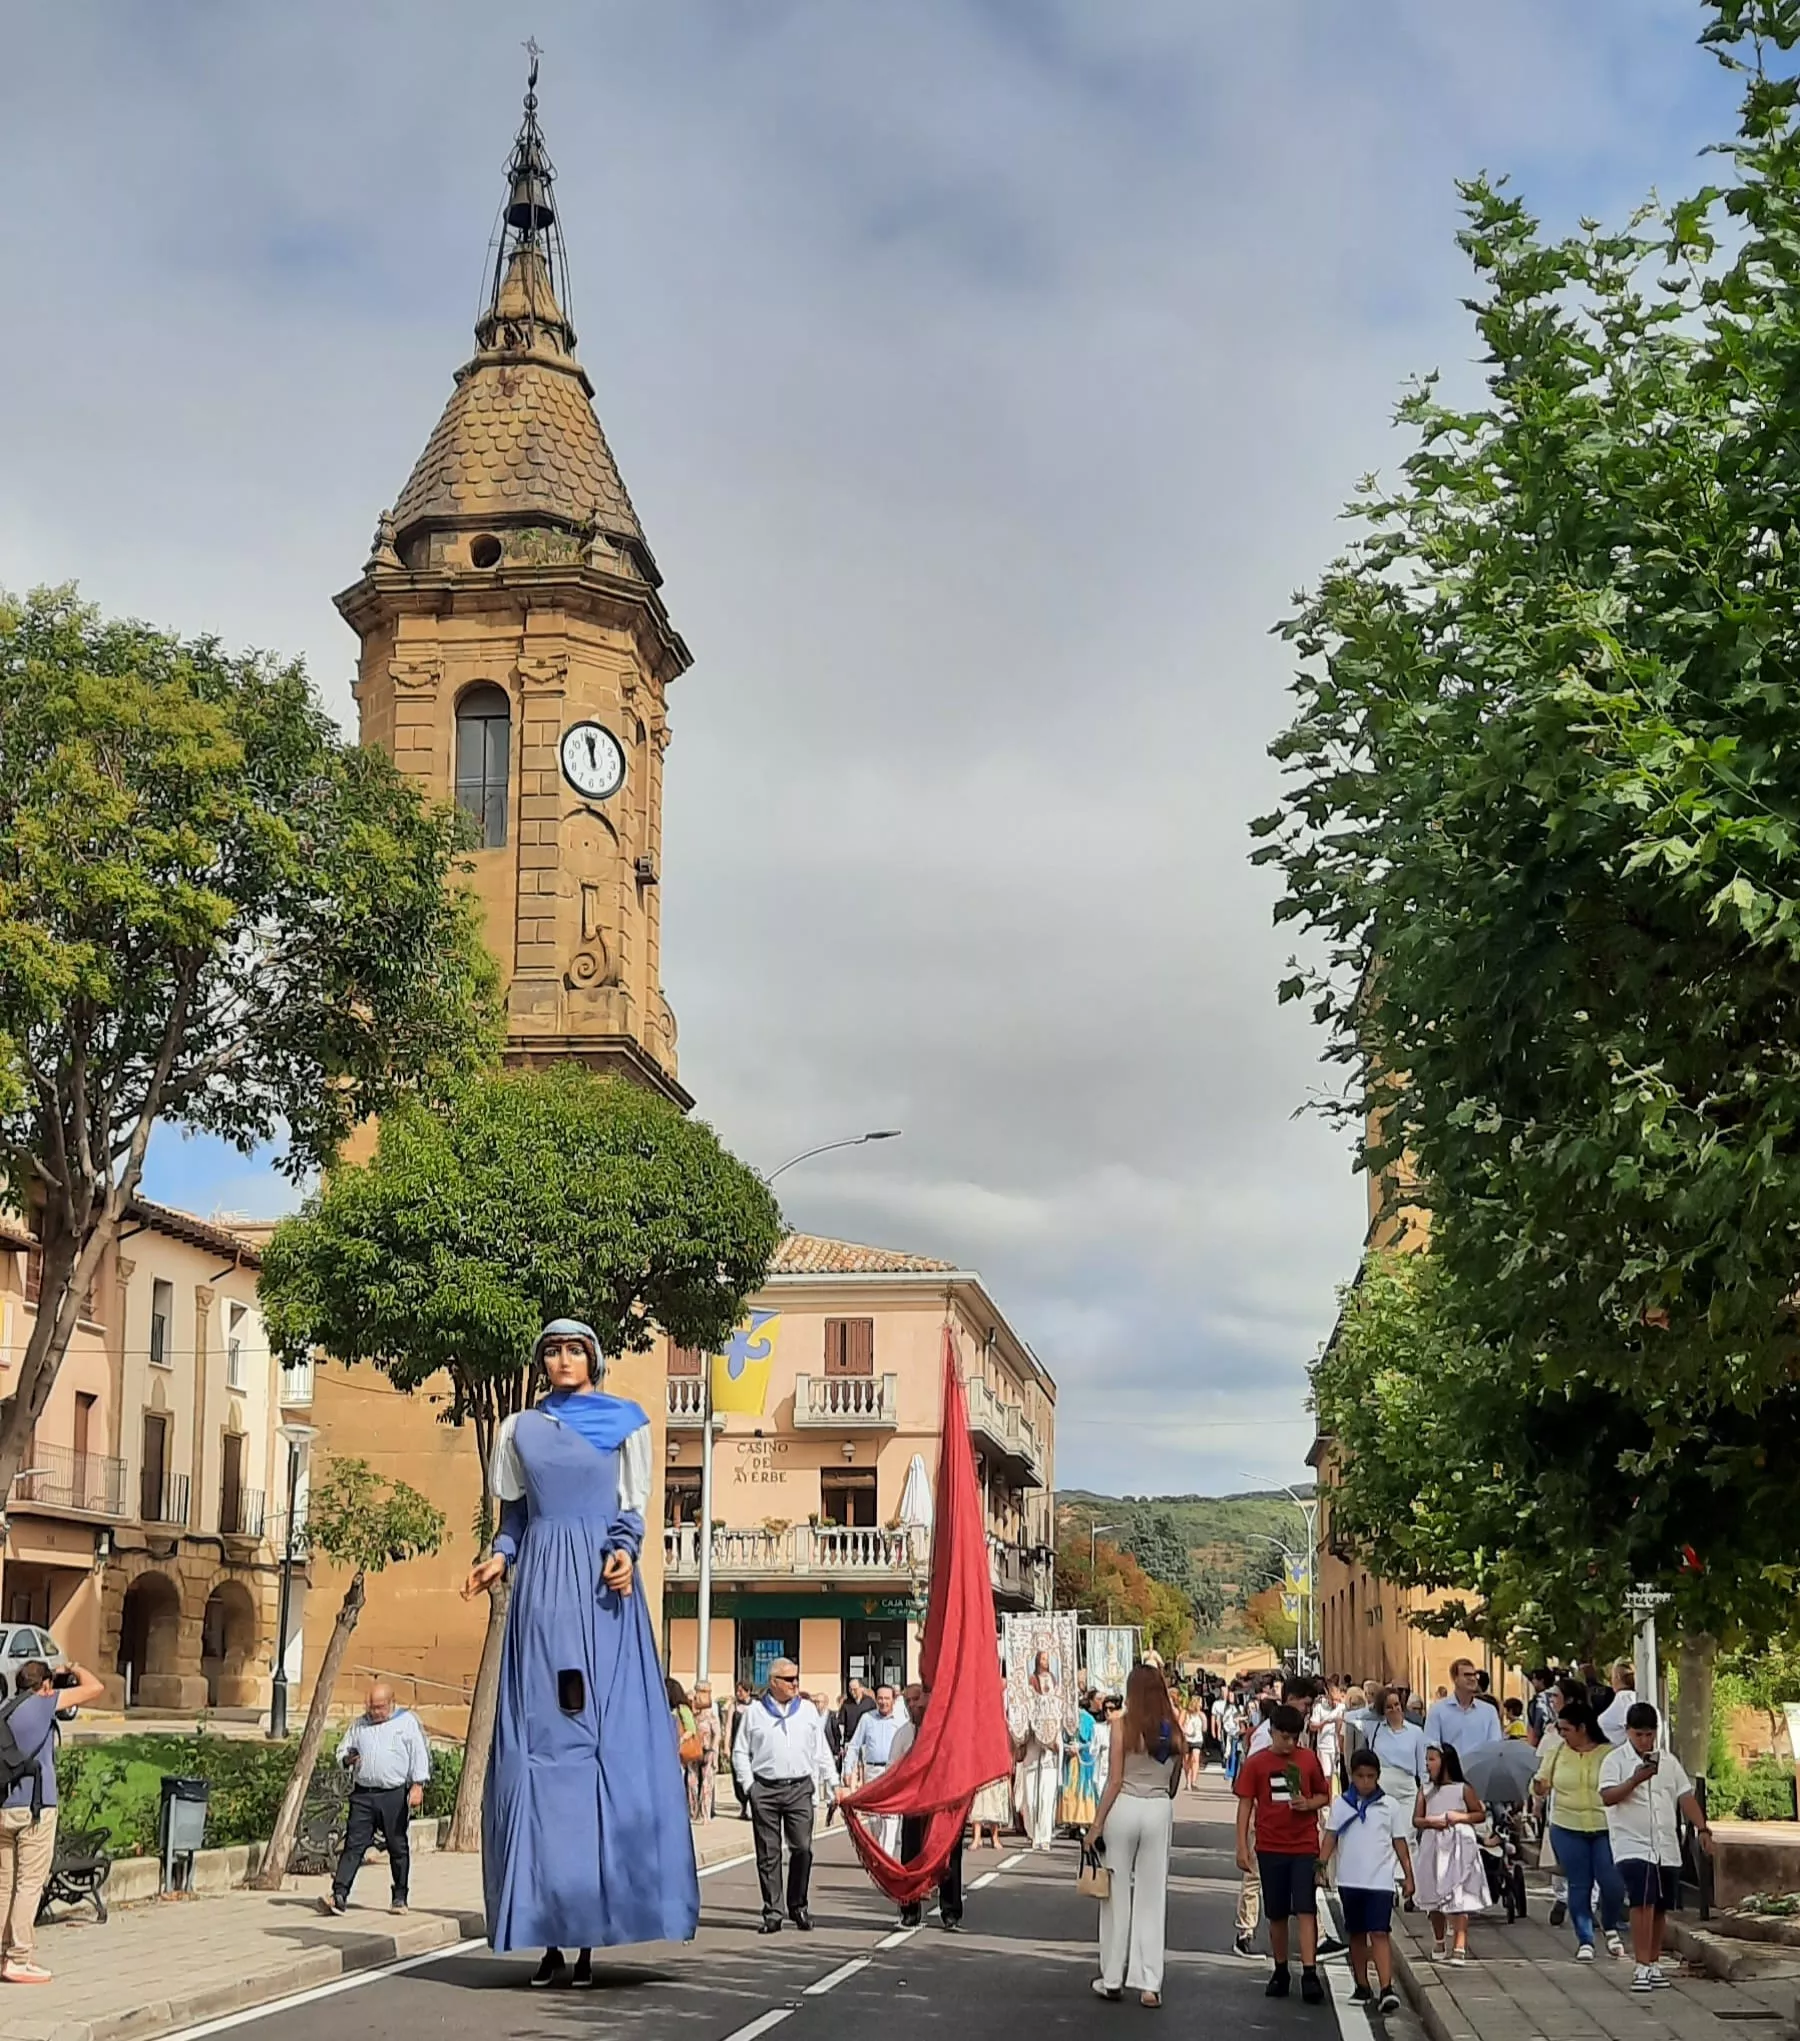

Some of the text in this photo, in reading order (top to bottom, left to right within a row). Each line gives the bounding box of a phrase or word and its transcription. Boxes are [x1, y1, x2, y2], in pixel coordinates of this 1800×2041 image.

[572, 740, 581, 749] 10
[569, 749, 574, 759] 9
[607, 747, 613, 757] 2
[572, 762, 576, 771] 8
[610, 761, 616, 770] 3
[579, 772, 584, 781] 7
[607, 771, 612, 780] 4
[589, 778, 594, 788] 6
[600, 778, 605, 787] 5
[737, 1441, 788, 1453] CASINO
[753, 1457, 771, 1469] DE
[733, 1471, 787, 1485] AYERBE
[881, 1599, 903, 1607] CAJA
